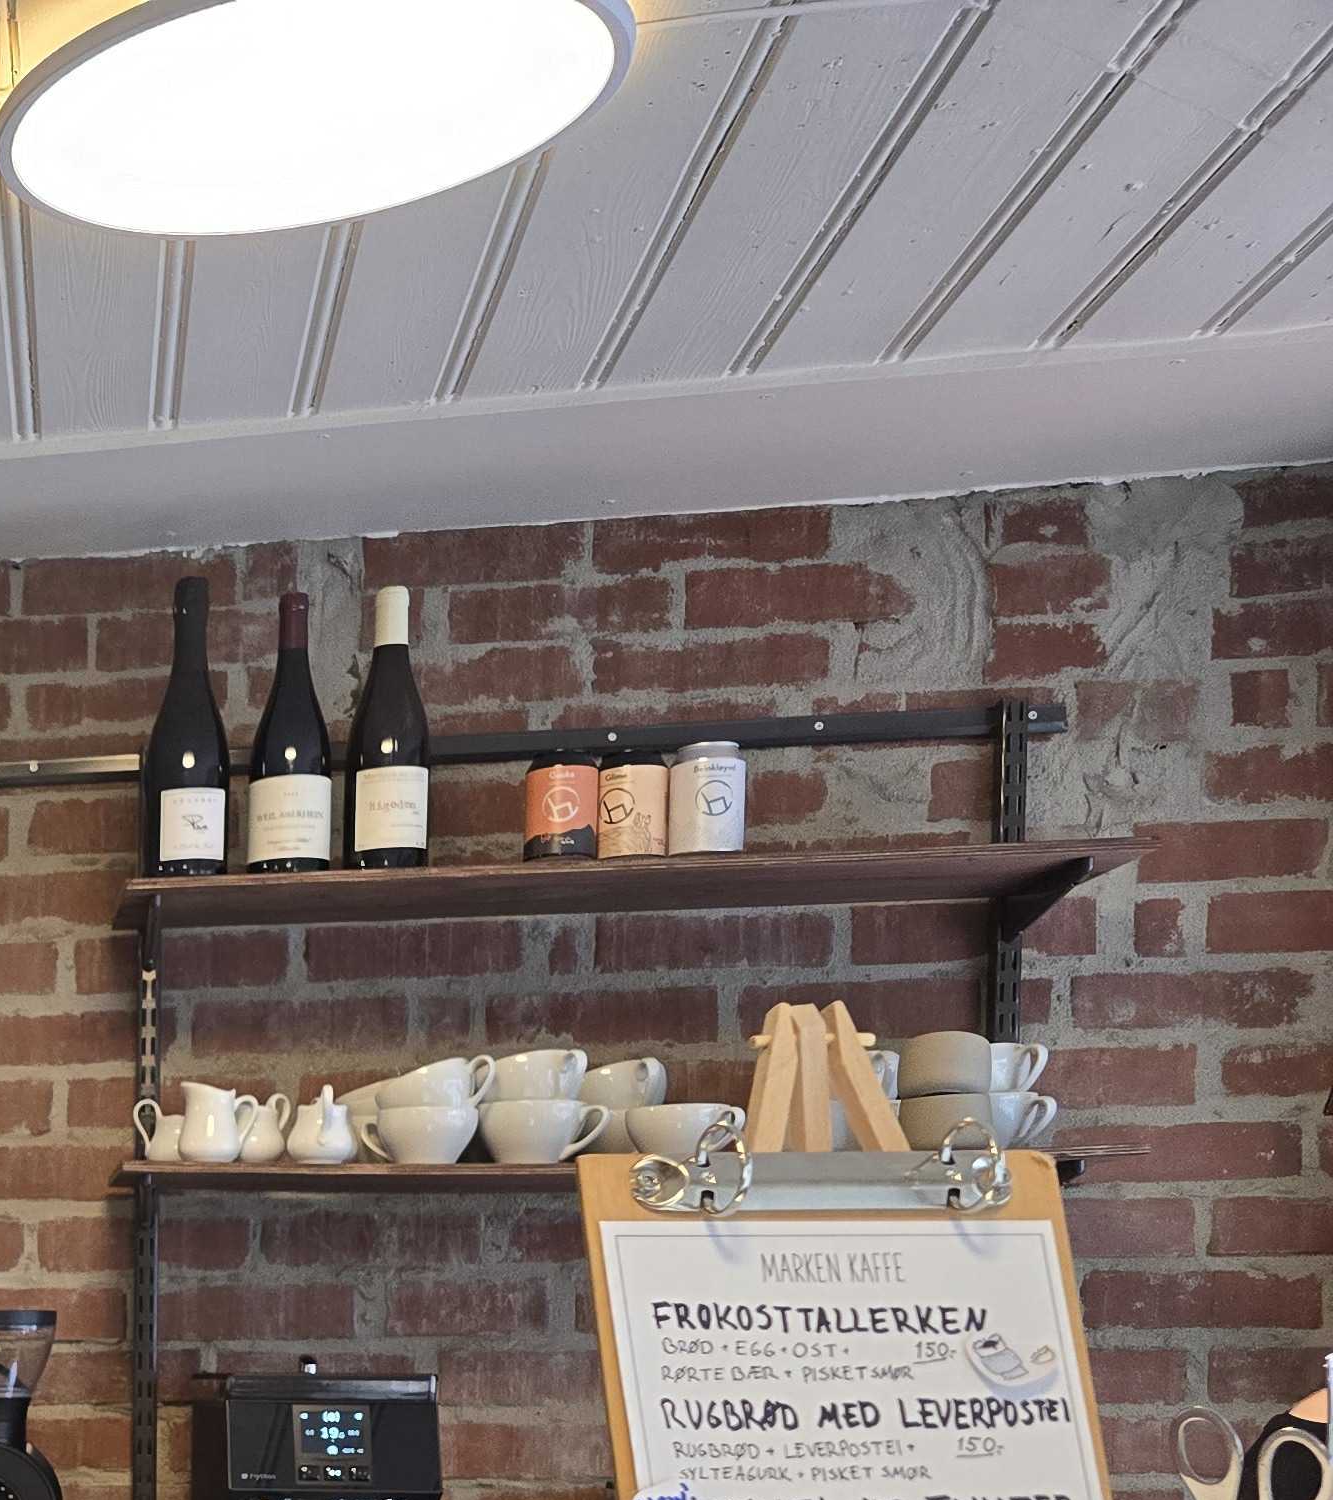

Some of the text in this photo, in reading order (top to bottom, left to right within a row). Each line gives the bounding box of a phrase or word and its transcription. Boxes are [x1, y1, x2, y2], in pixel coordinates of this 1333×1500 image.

[761, 1252, 906, 1284] MARKEN KAFFE
[651, 1301, 988, 1334] FROKOSTTALLERKEN
[661, 1338, 715, 1356] BRØD
[734, 1340, 776, 1359] EGG
[792, 1342, 839, 1359] OST
[661, 1397, 1071, 1431] RUGBRØD MED LEVERPOSTEI
[785, 1440, 903, 1459] LEVERPOSTEI
